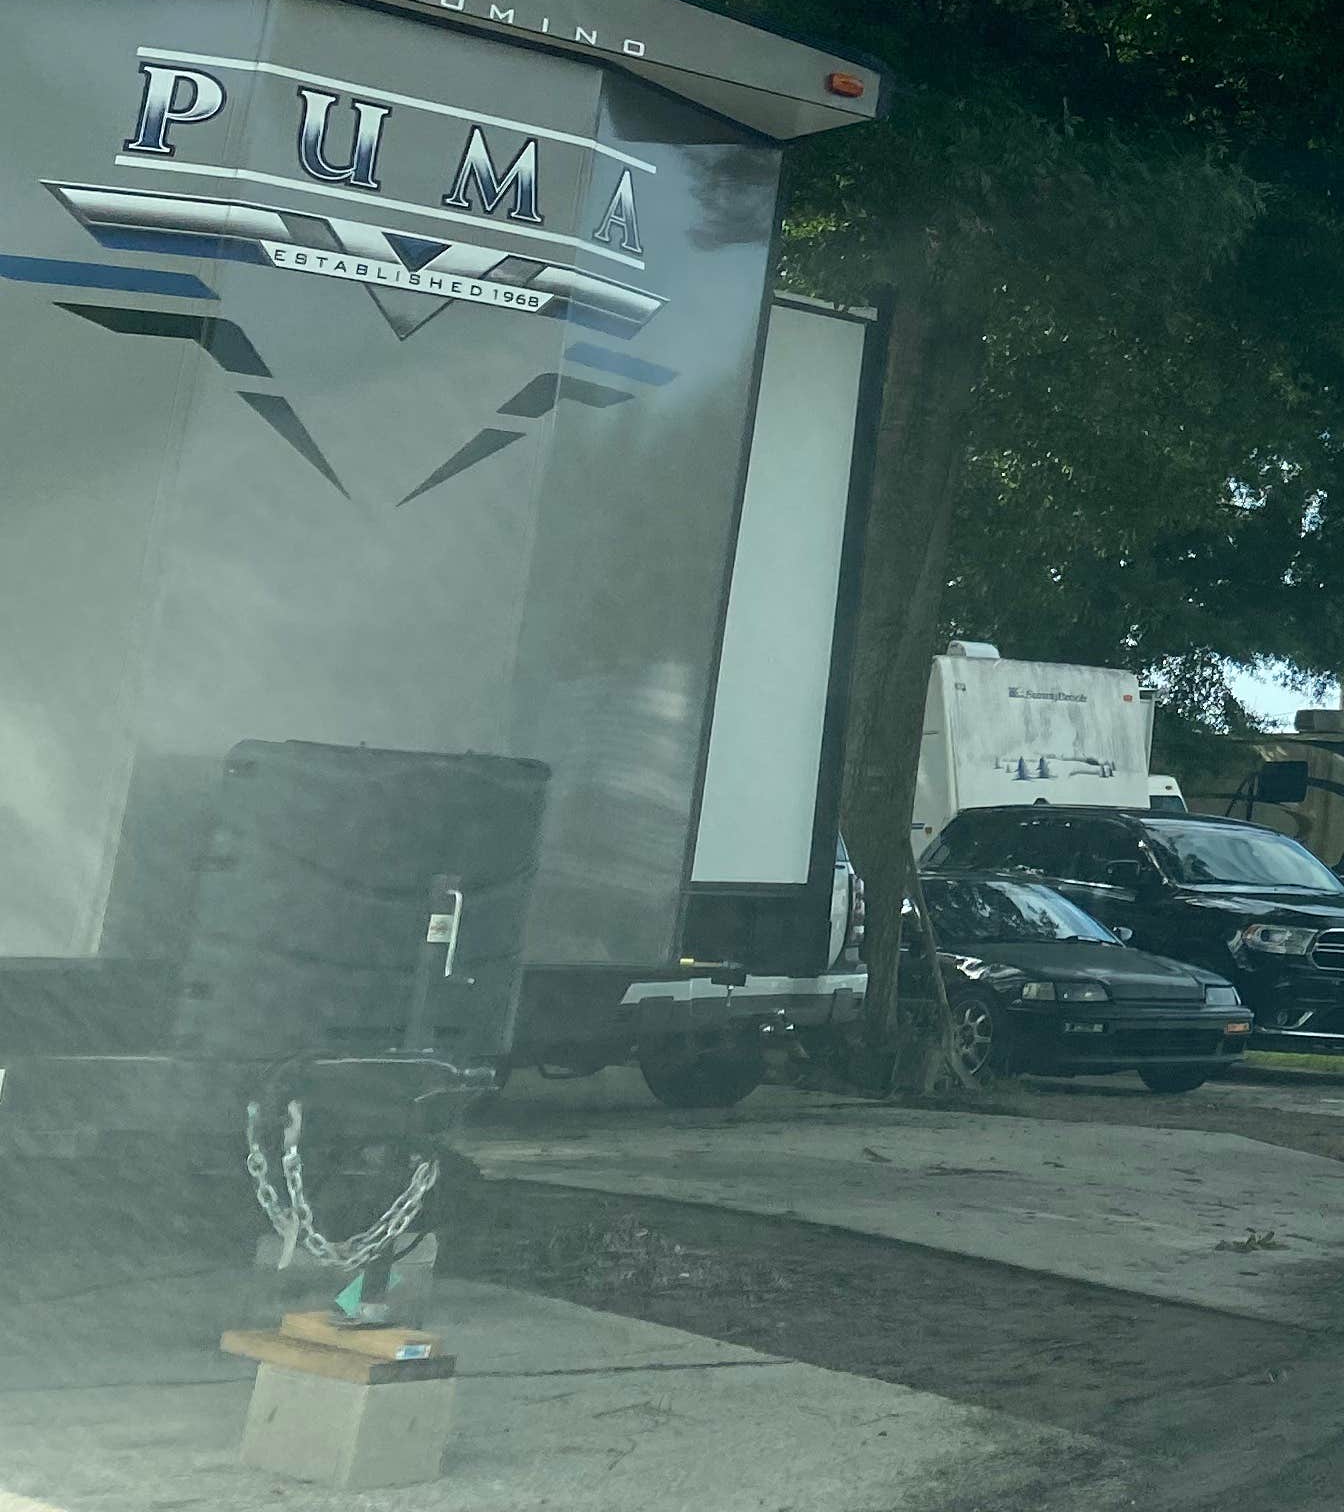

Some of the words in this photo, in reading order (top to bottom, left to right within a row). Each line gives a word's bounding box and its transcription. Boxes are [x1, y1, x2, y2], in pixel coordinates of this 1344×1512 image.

[122, 61, 646, 255] PUMA
[273, 248, 484, 297] ESTABLISHED
[493, 288, 540, 308] 1968
